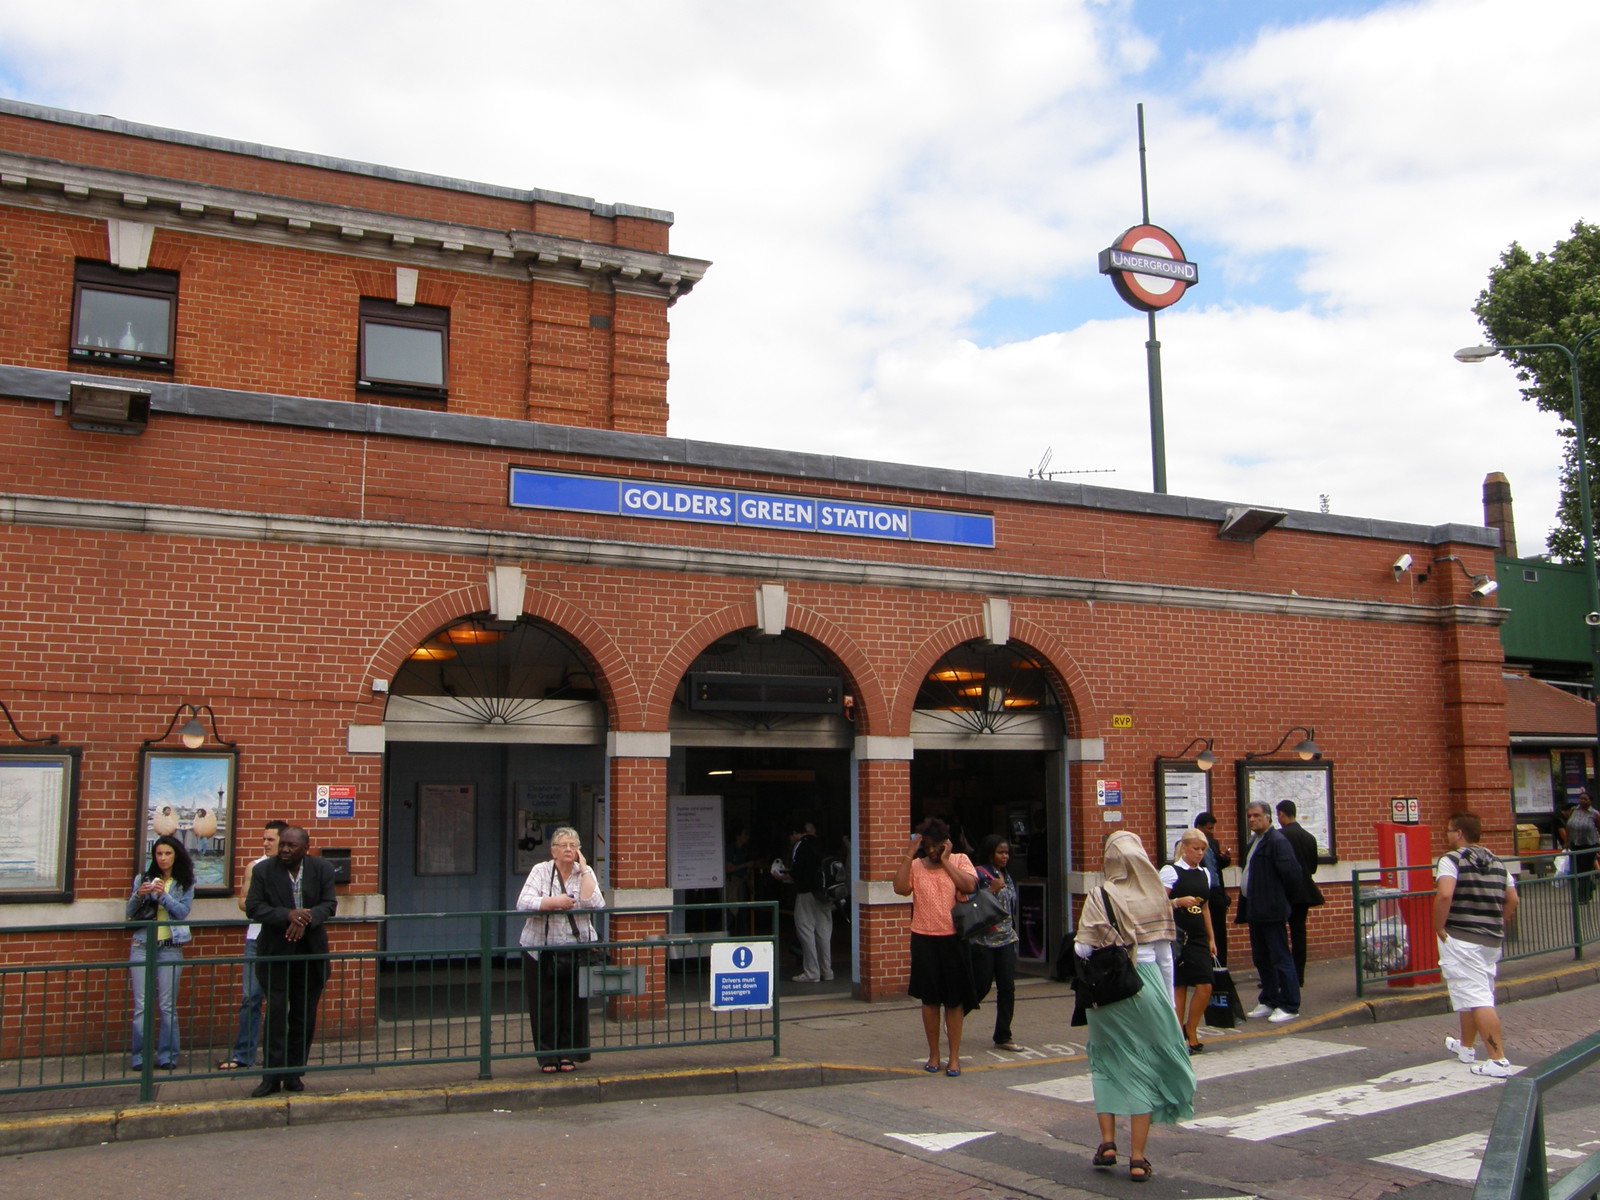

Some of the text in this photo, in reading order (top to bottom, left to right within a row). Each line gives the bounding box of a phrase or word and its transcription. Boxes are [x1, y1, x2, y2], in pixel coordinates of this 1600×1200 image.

[1112, 251, 1195, 278] UNDERGROUND
[624, 488, 907, 532] GOLDERS GREEN STATION
[1114, 716, 1131, 726] RVP
[1208, 995, 1228, 1006] ALE
[986, 1042, 1087, 1063] IGHT
